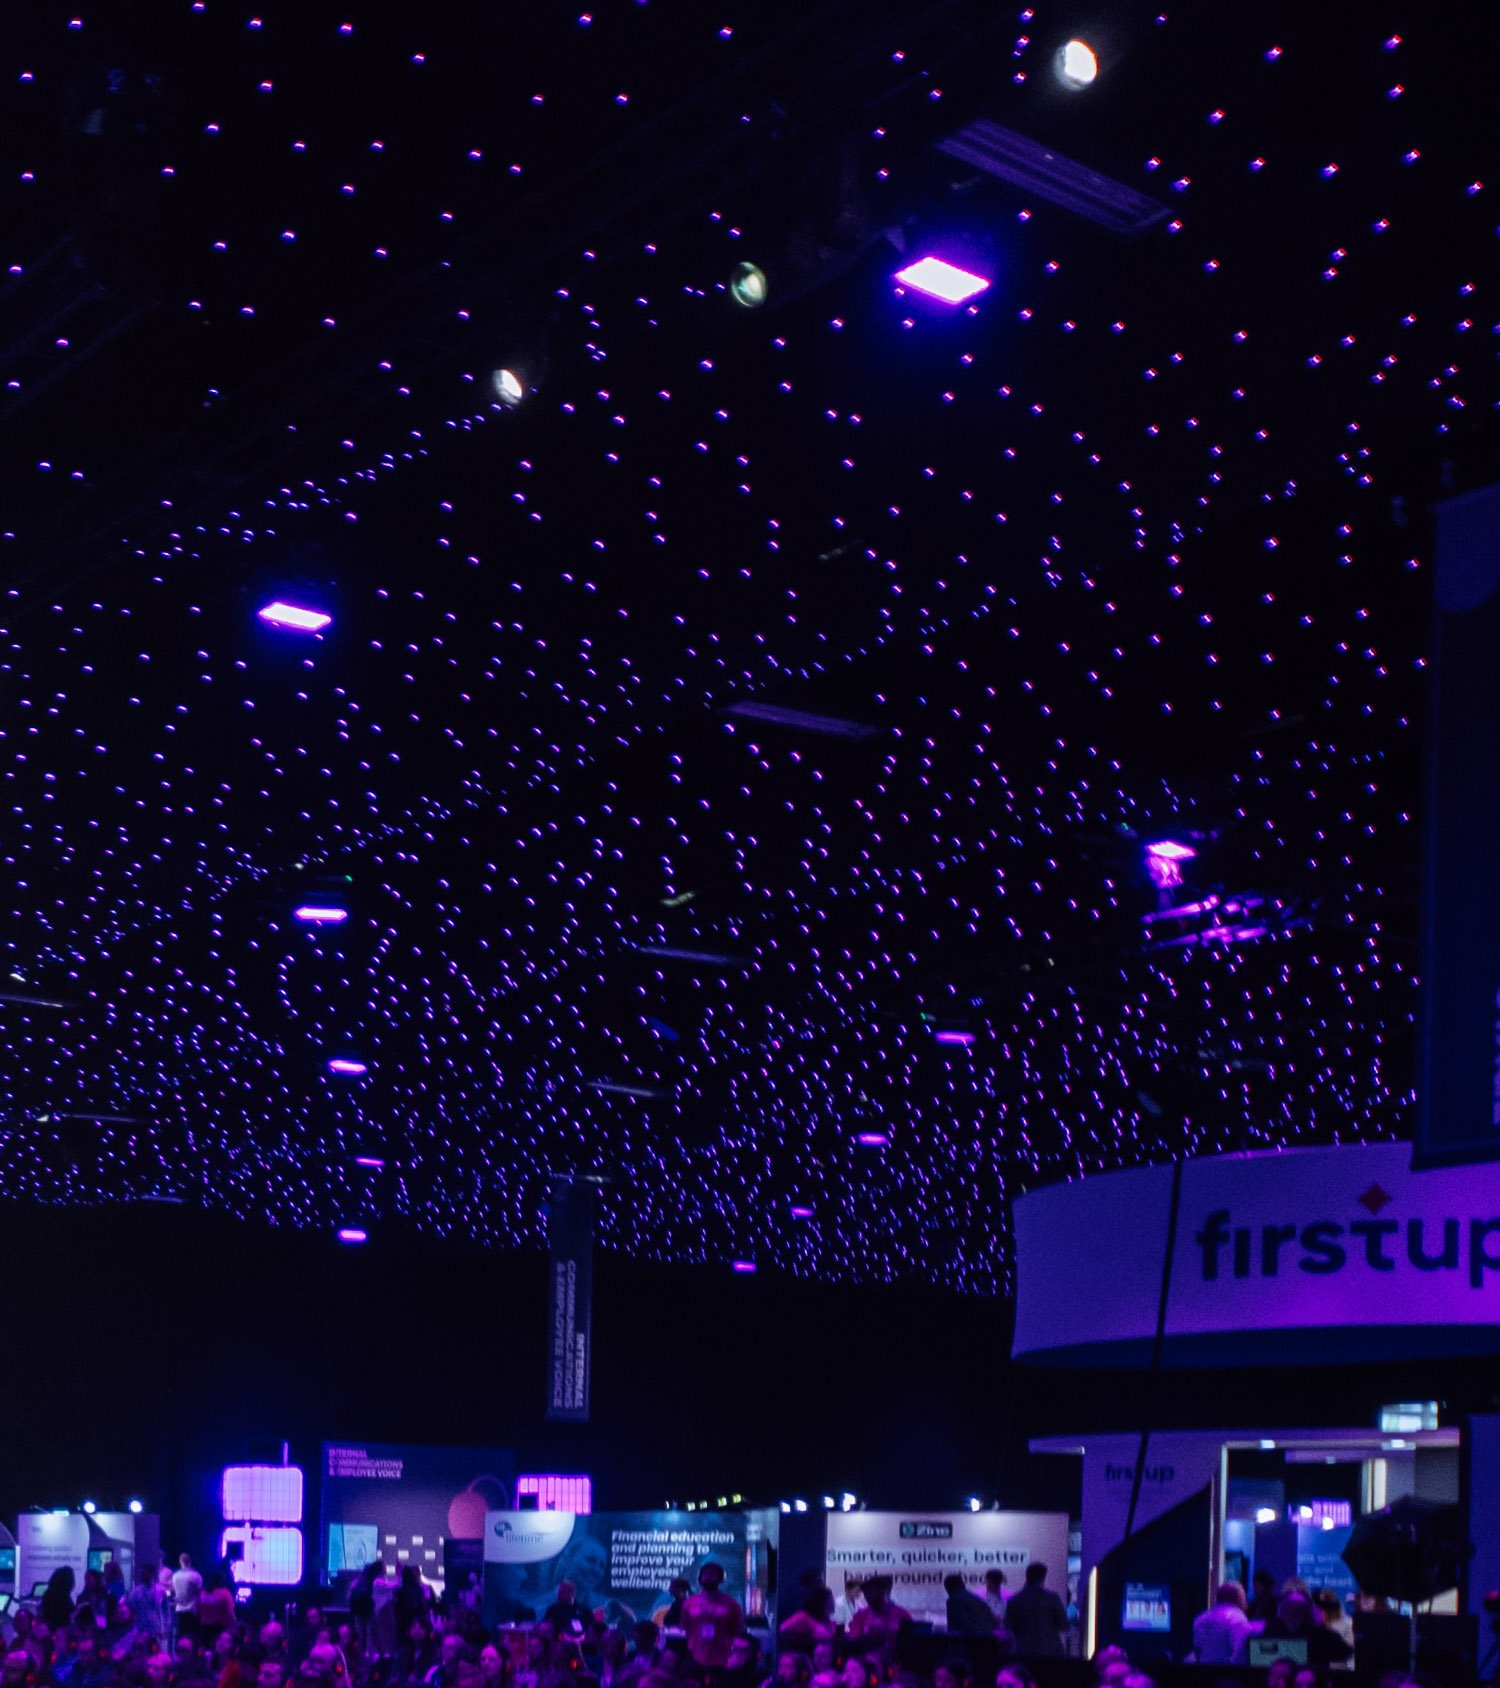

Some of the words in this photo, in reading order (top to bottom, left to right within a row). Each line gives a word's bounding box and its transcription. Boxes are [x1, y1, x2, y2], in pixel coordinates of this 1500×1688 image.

[565, 1259, 576, 1408] COMMUNICATIONS
[575, 1332, 585, 1408] INTERNAL
[378, 1468, 402, 1479] VOICE
[1106, 1464, 1175, 1484] firsup
[611, 1530, 669, 1543] Financial
[670, 1530, 735, 1544] education
[611, 1543, 635, 1554] and
[637, 1543, 694, 1557] planning
[697, 1544, 710, 1555] to
[827, 1548, 896, 1565] Smarter,
[901, 1548, 968, 1565] quicker,
[974, 1548, 1027, 1564] better
[665, 1556, 695, 1568] your
